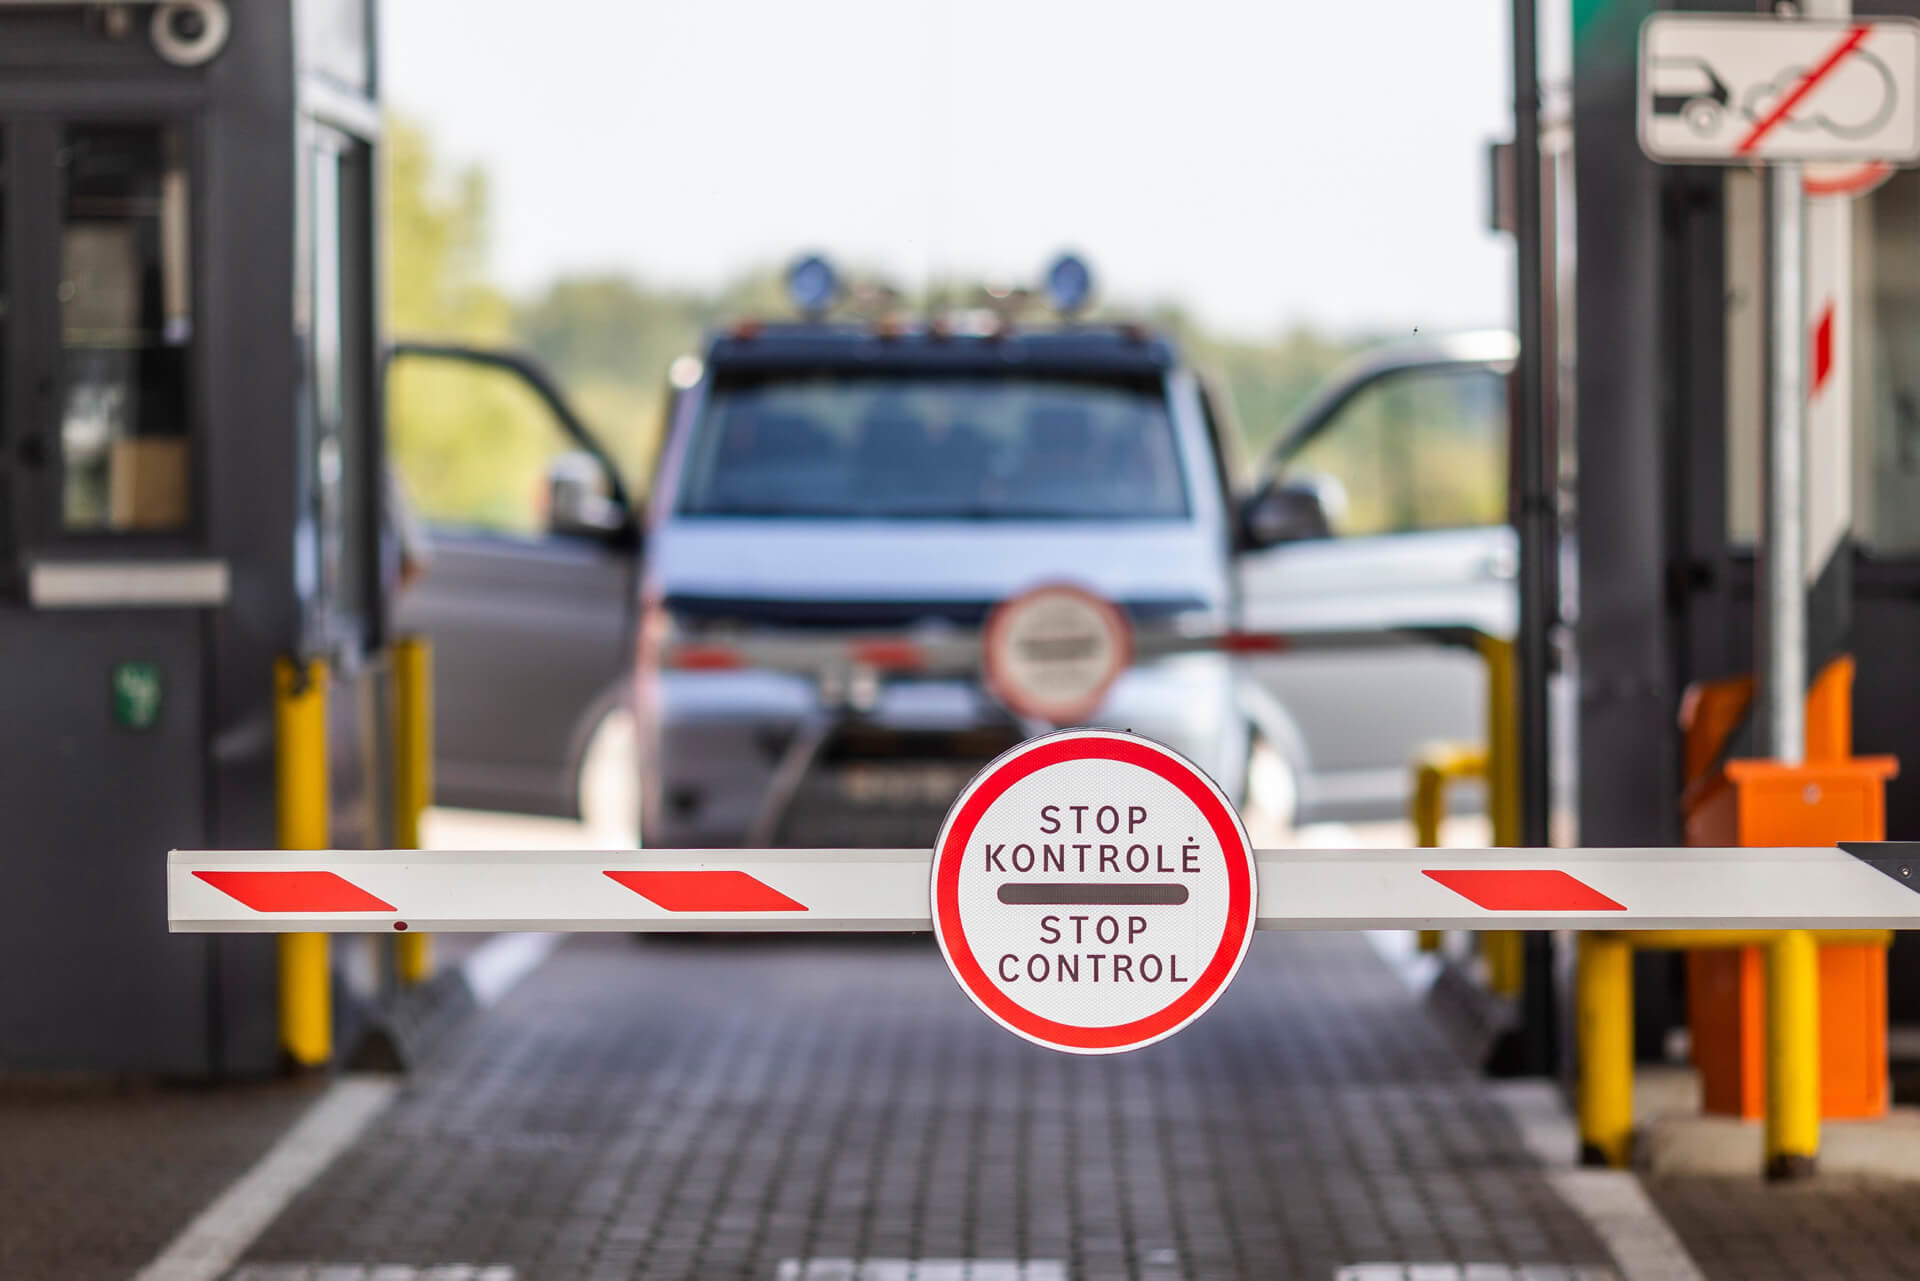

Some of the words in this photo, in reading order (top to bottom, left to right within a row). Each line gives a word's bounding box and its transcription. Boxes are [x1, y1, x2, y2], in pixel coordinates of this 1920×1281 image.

[1040, 805, 1148, 834] STOP
[985, 836, 1201, 873] KONTROLĖ
[1040, 915, 1148, 944] STOP
[998, 953, 1188, 982] CONTROL
